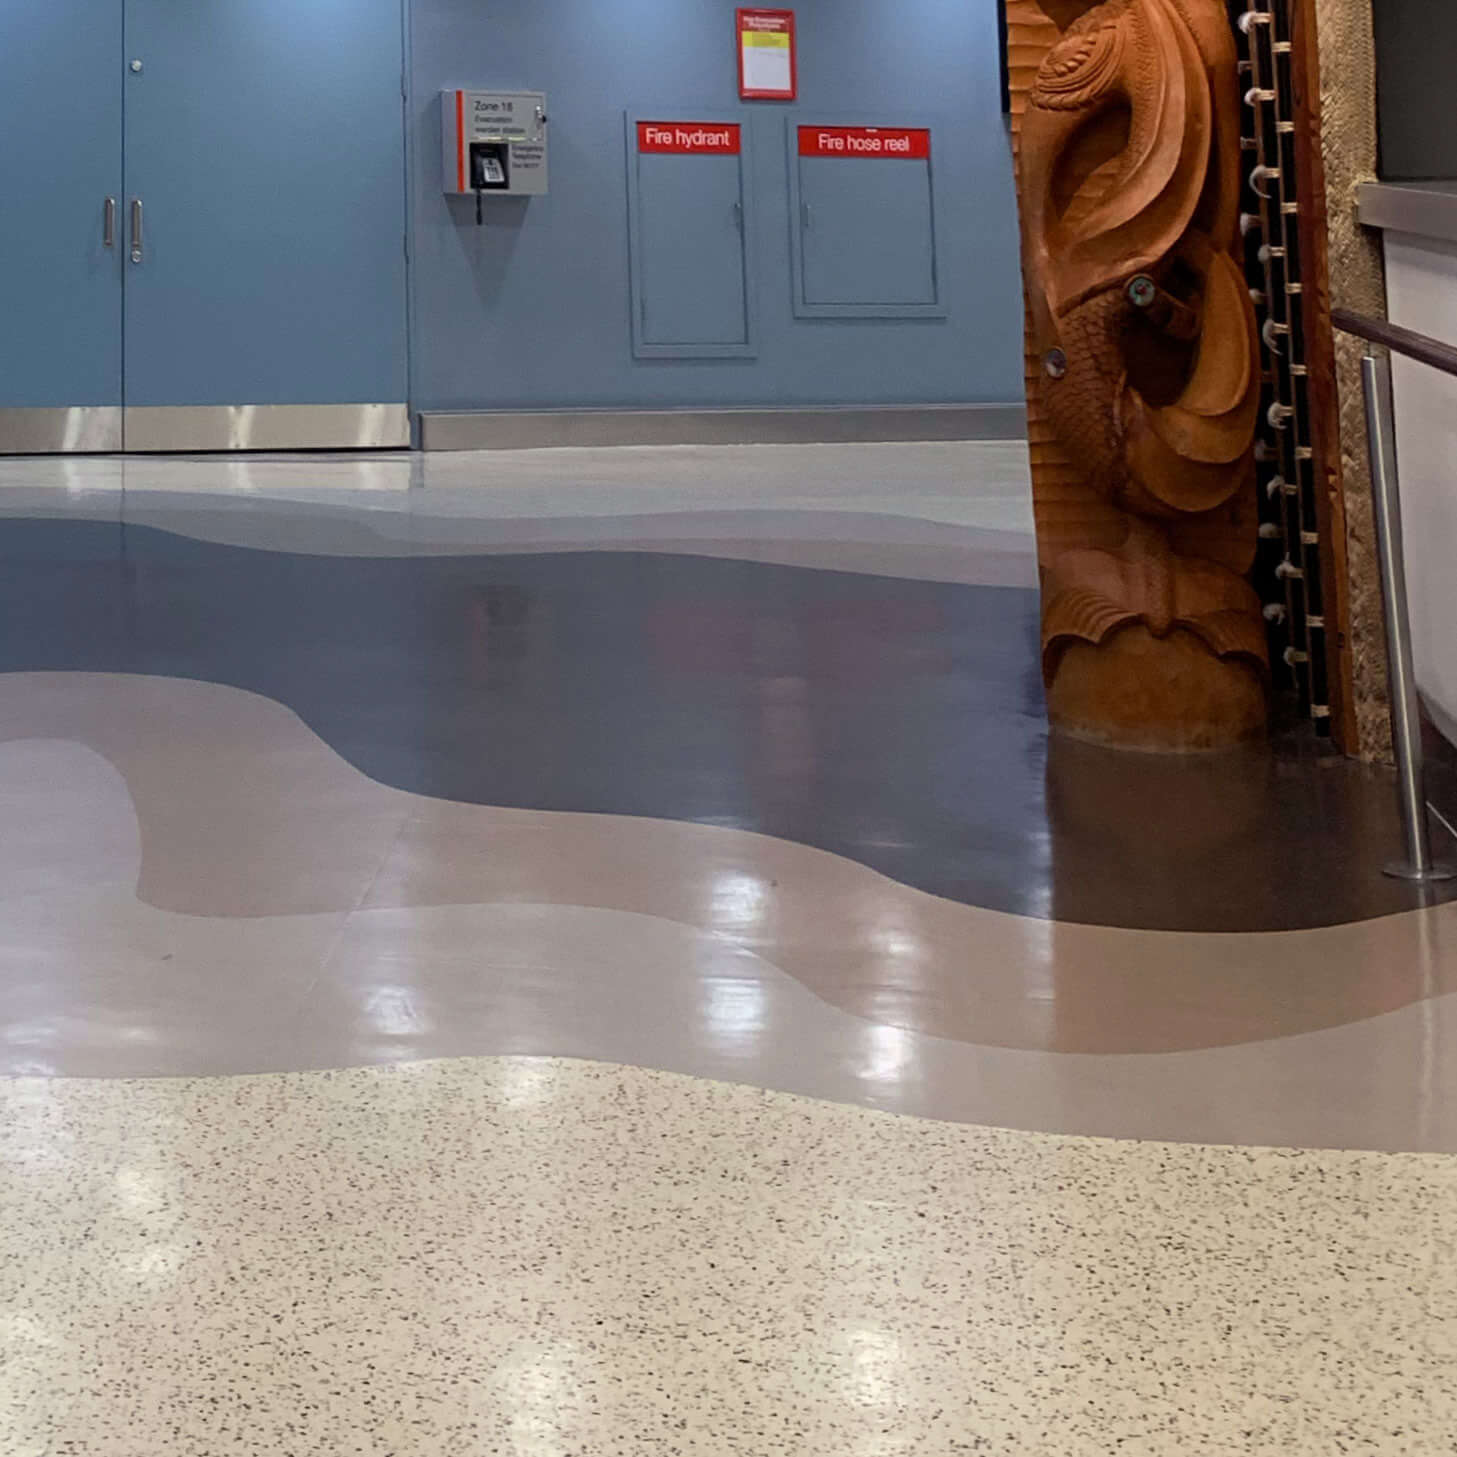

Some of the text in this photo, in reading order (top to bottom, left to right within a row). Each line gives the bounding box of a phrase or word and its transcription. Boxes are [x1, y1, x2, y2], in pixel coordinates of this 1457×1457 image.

[474, 101, 499, 111] Zone
[645, 127, 730, 149] Fire hydrant
[817, 132, 910, 152] Fire hose reel
